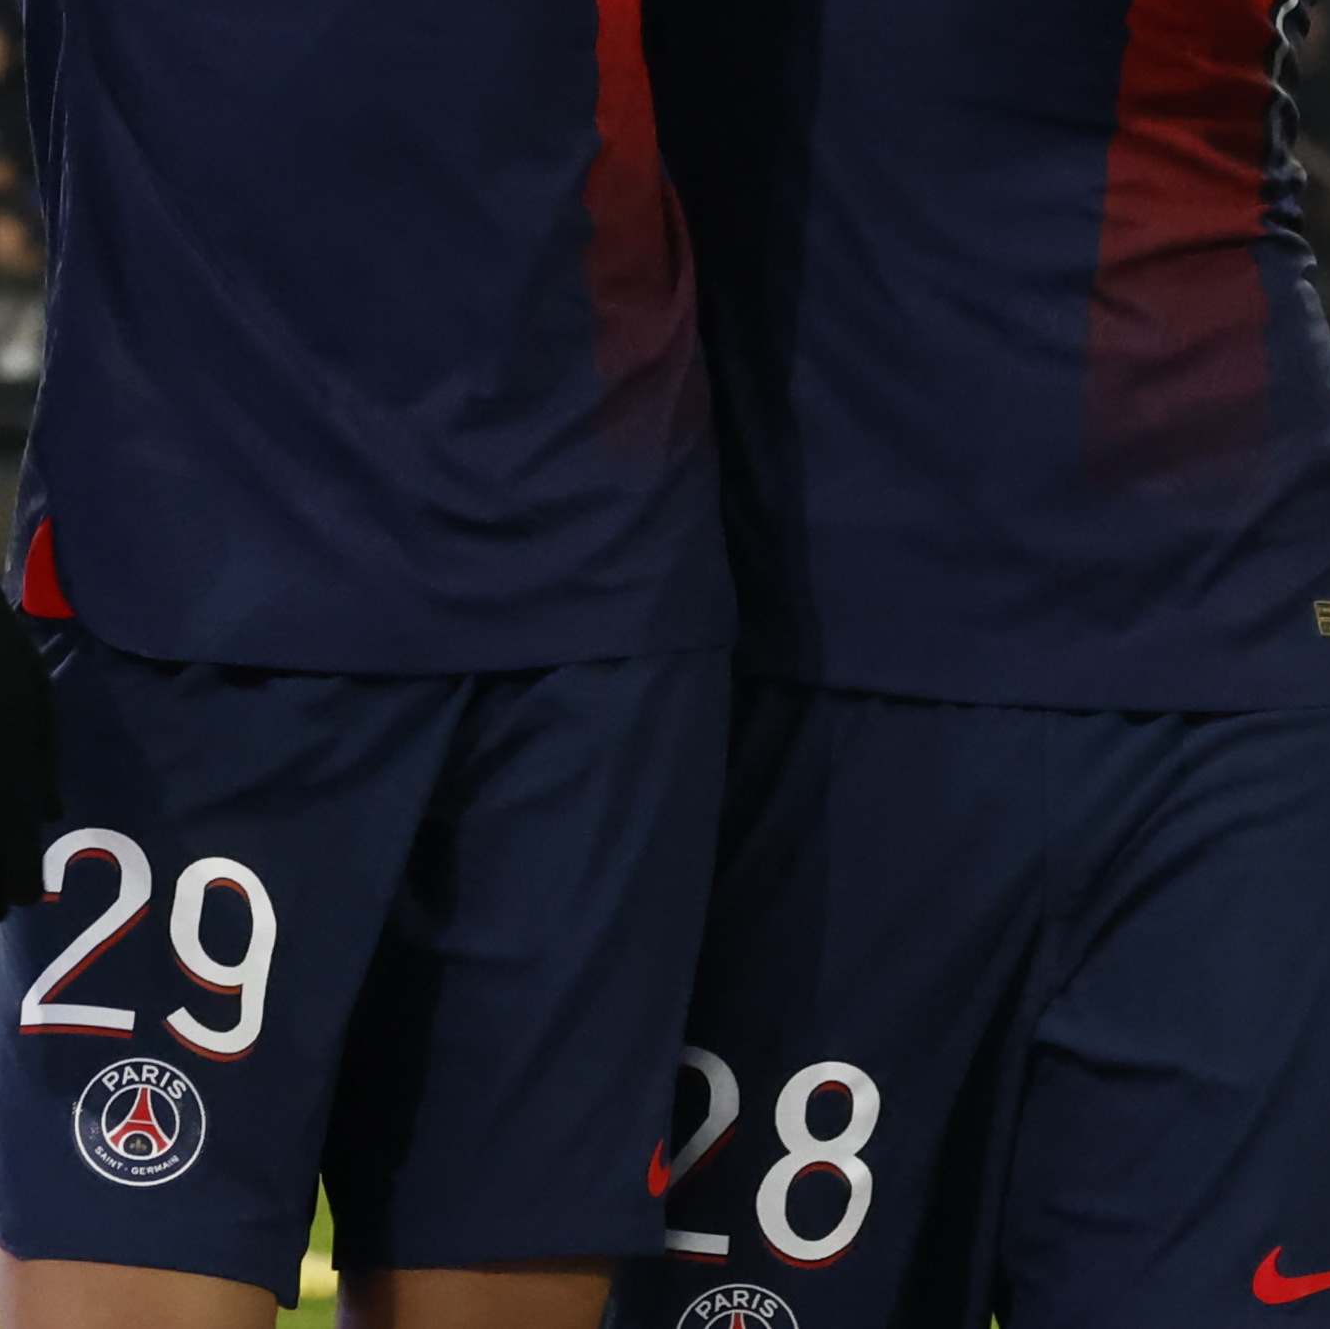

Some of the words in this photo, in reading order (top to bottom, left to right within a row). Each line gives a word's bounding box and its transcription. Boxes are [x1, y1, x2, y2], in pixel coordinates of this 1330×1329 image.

[19, 827, 277, 1060] 29
[101, 1064, 188, 1101] PARIS
[94, 1145, 124, 1172] SAINT
[131, 1154, 180, 1176] GERMAIN
[664, 1045, 881, 1267] 28
[694, 1290, 779, 1321] PARIS
